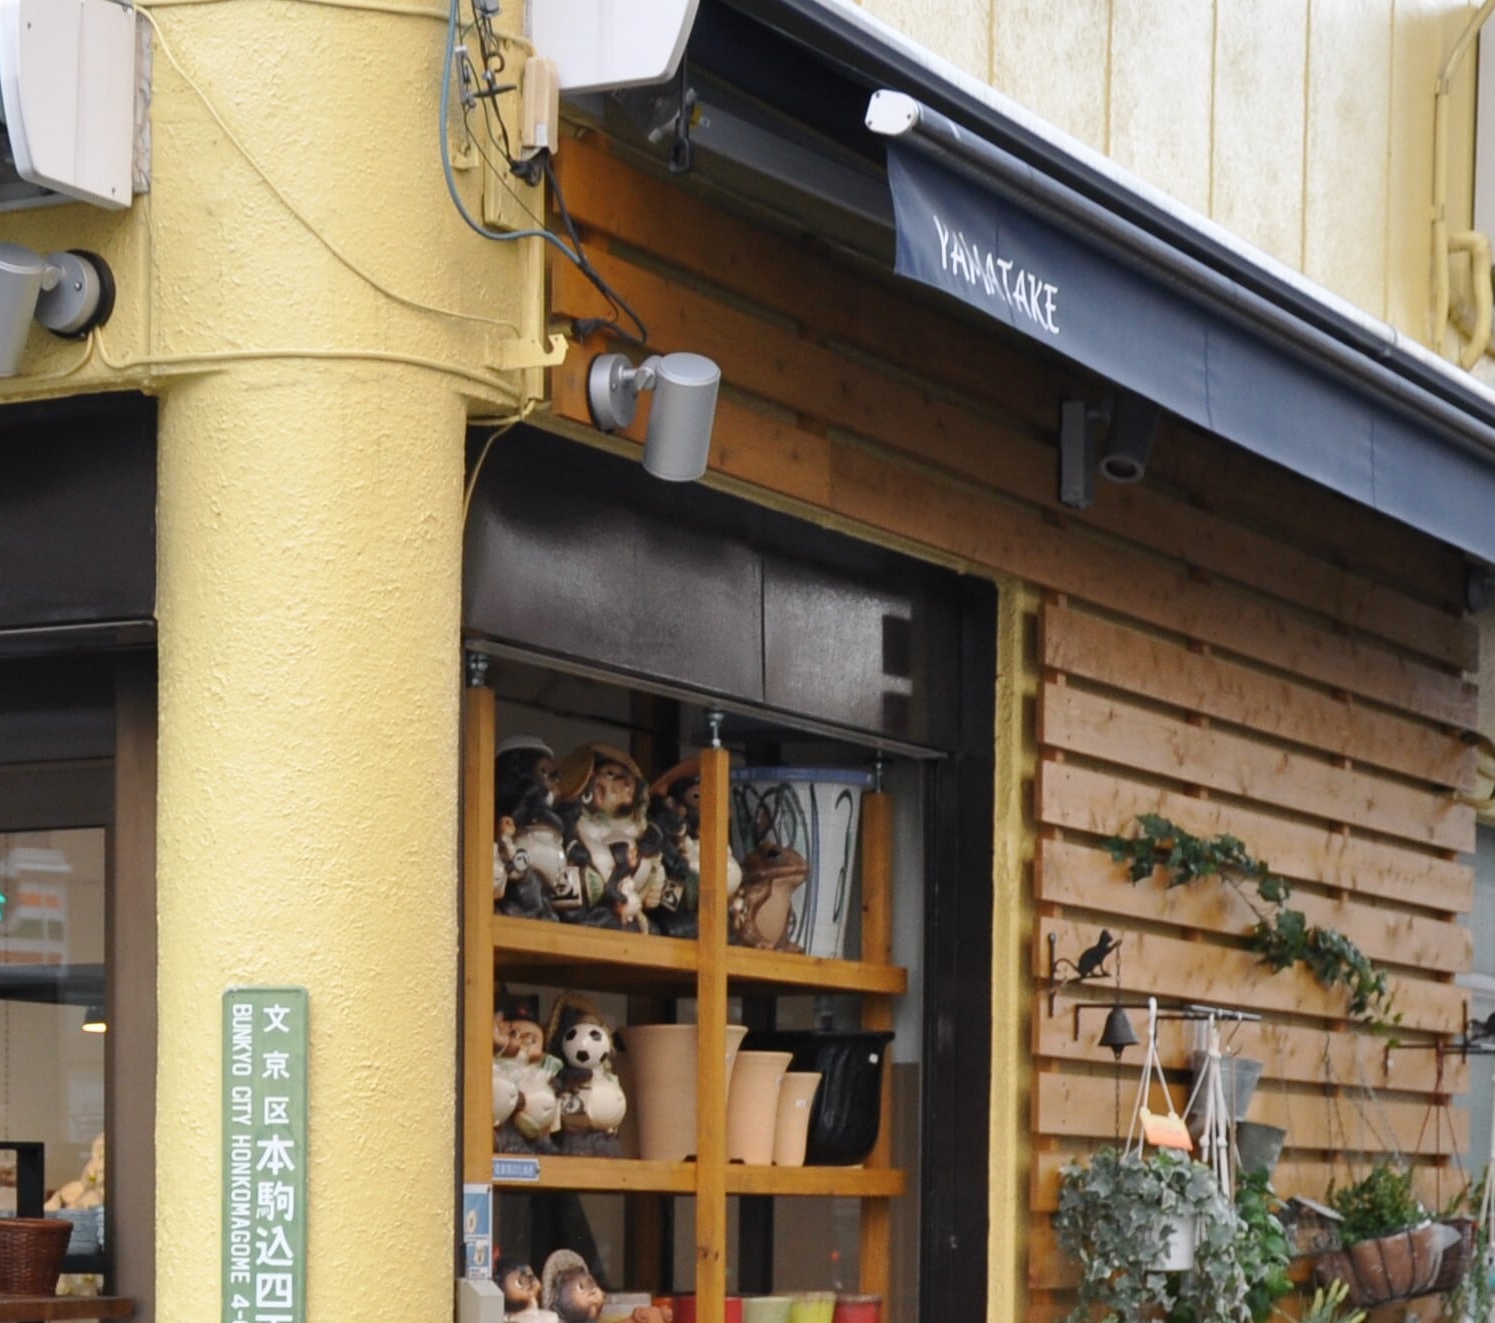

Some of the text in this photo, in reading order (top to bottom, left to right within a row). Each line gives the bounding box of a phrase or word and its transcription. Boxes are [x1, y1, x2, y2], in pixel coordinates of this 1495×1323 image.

[933, 215, 1060, 334] YAMATAKE
[231, 1003, 253, 1077] BUNKYO
[262, 1003, 291, 1126] 文京区
[231, 1085, 253, 1127] CITY
[229, 1134, 252, 1284] HONKOMAGOME
